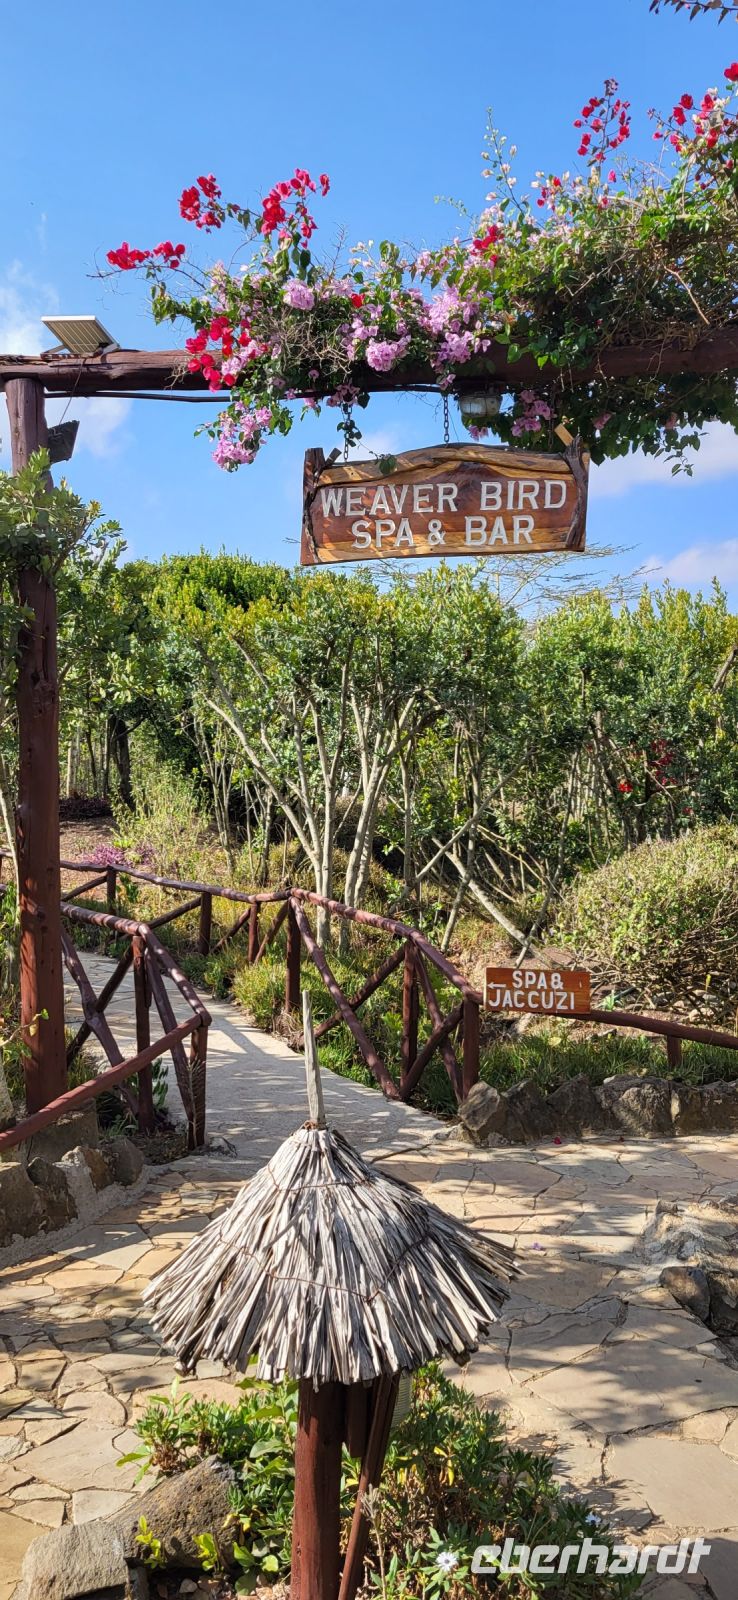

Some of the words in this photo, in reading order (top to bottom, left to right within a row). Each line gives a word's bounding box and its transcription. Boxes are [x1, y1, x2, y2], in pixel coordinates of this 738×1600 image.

[320, 482, 458, 517] WEAVER
[480, 480, 567, 511] BIRD
[351, 517, 414, 549] SPA
[427, 518, 446, 546] &
[464, 515, 535, 546] BAR
[488, 989, 575, 1010] JACCUZI
